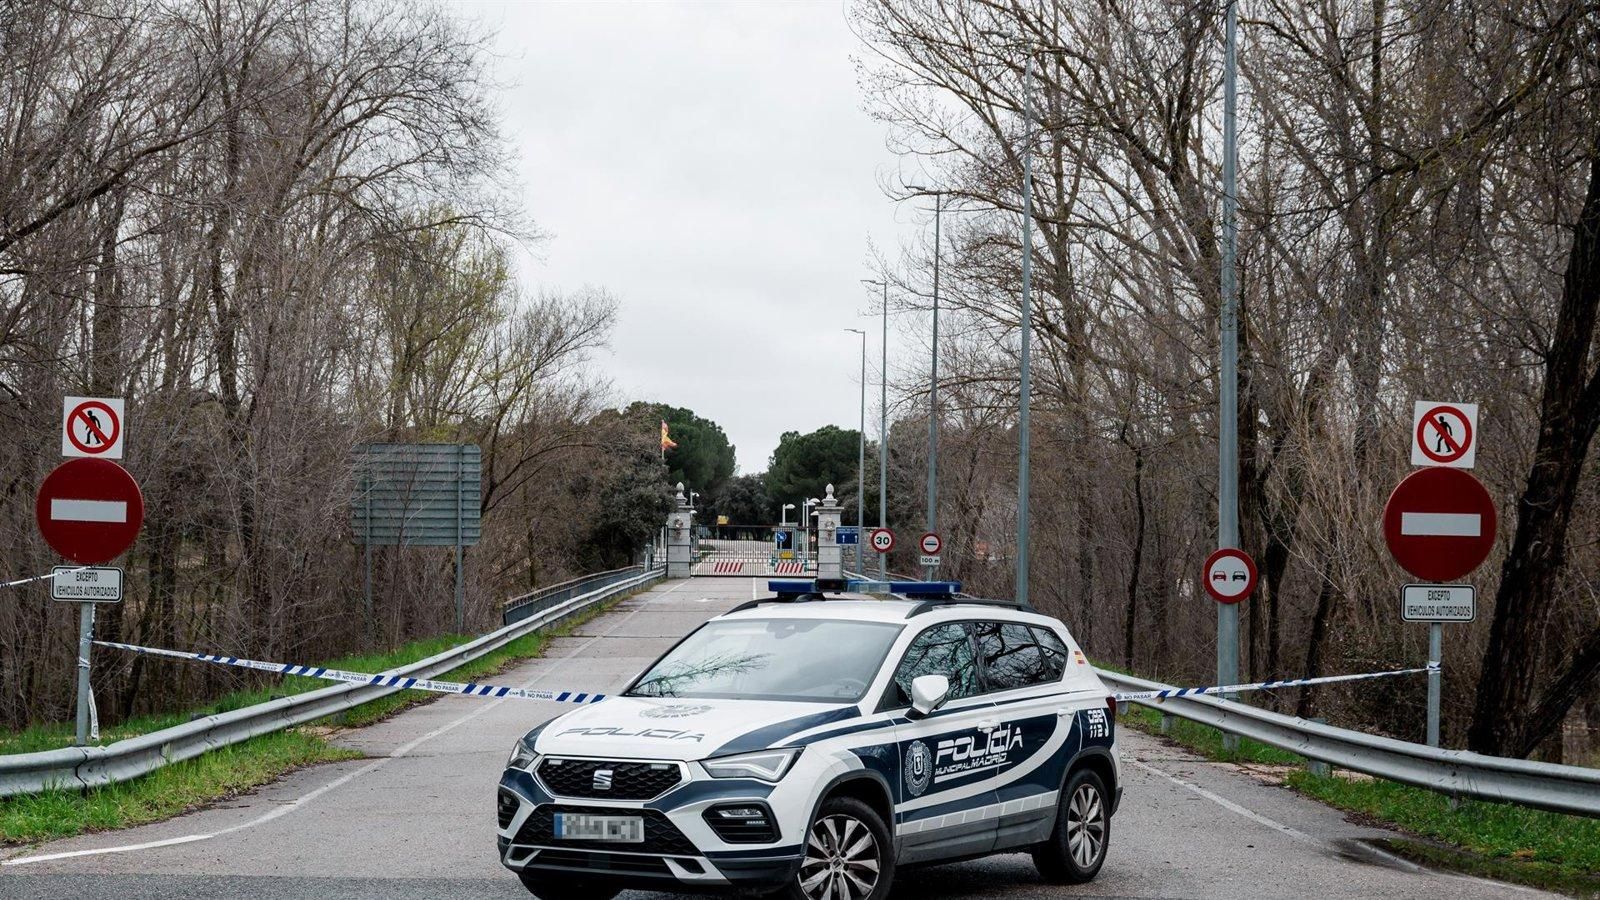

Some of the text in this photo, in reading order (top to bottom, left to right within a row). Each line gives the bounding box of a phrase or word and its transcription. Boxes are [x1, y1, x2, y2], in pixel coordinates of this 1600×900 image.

[876, 536, 890, 545] 30
[76, 571, 99, 582] EXCEPTO
[56, 585, 117, 597] VEHICULOS AUTORIZADOS
[1428, 590, 1451, 601] EXCEPTO
[1407, 605, 1471, 617] VEHICULOS AUTORIZADOS
[1089, 724, 1103, 739] 112
[935, 752, 1008, 776] MUNICIPAL MADRID
